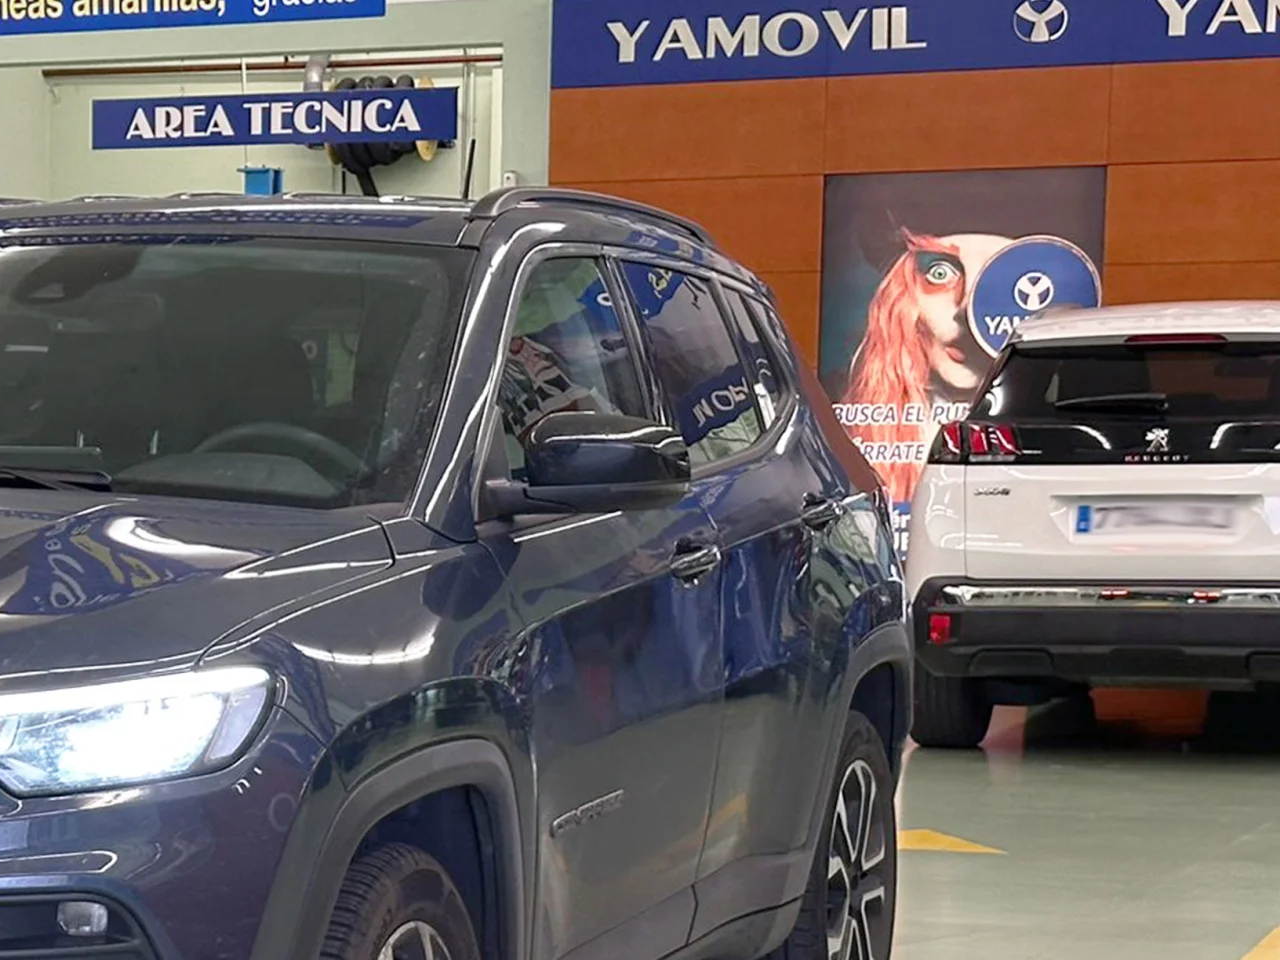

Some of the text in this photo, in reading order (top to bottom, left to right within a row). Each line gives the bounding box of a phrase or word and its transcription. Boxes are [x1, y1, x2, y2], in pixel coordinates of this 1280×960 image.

[607, 6, 927, 63] YAMOVIL
[126, 98, 421, 140] AREA TECNICA
[904, 404, 925, 424] EL
[859, 441, 926, 462] RRATE
